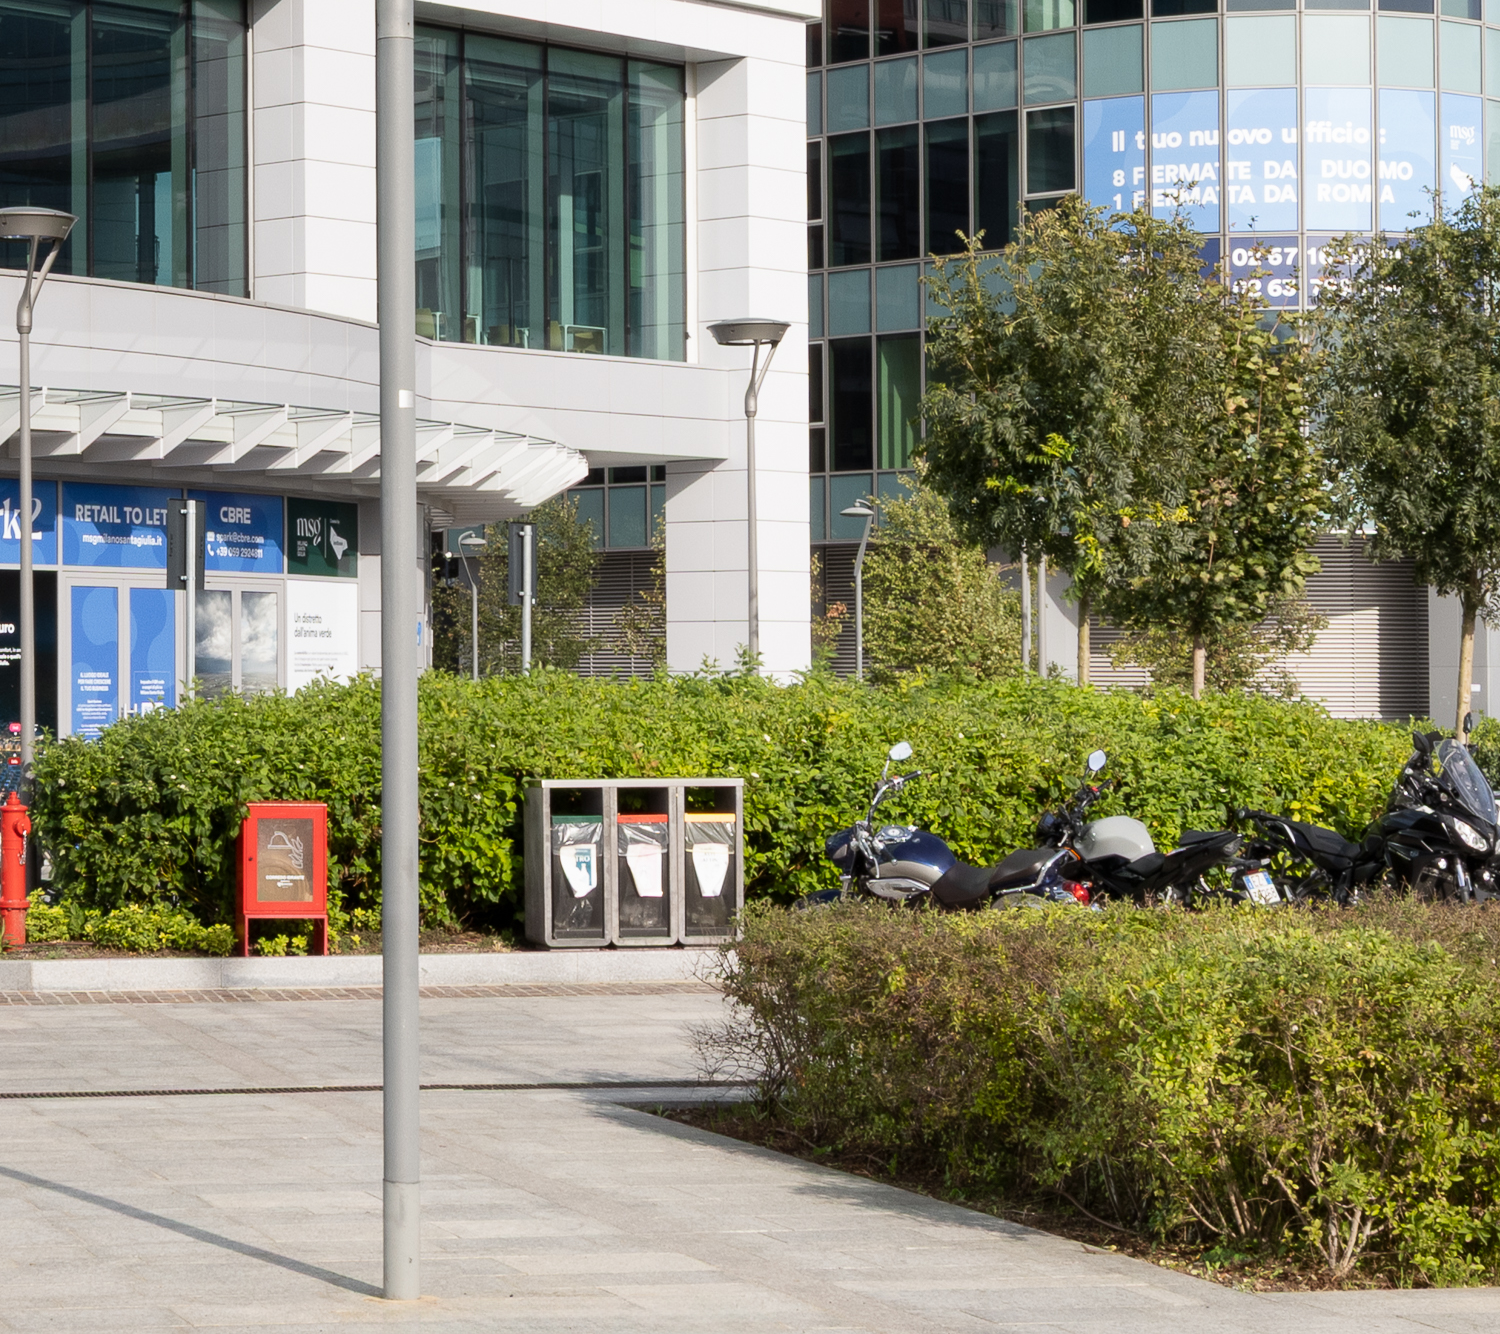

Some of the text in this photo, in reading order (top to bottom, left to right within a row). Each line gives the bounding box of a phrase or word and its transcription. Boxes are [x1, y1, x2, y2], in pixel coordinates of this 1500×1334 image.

[1450, 125, 1475, 146] msg
[1112, 169, 1125, 186] 8
[1264, 160, 1297, 179] DA
[1321, 159, 1413, 181] DUOMO
[1113, 193, 1122, 210] 1
[1264, 184, 1297, 203] DA
[1267, 247, 1298, 265] 67
[75, 504, 167, 526] RETAIL TO LET
[219, 506, 251, 524] CBRE
[82, 532, 163, 548] msgmilanosantagiulia.it
[216, 532, 265, 544] spark@cbre.com
[296, 516, 321, 547] msg
[216, 547, 228, 557] +39
